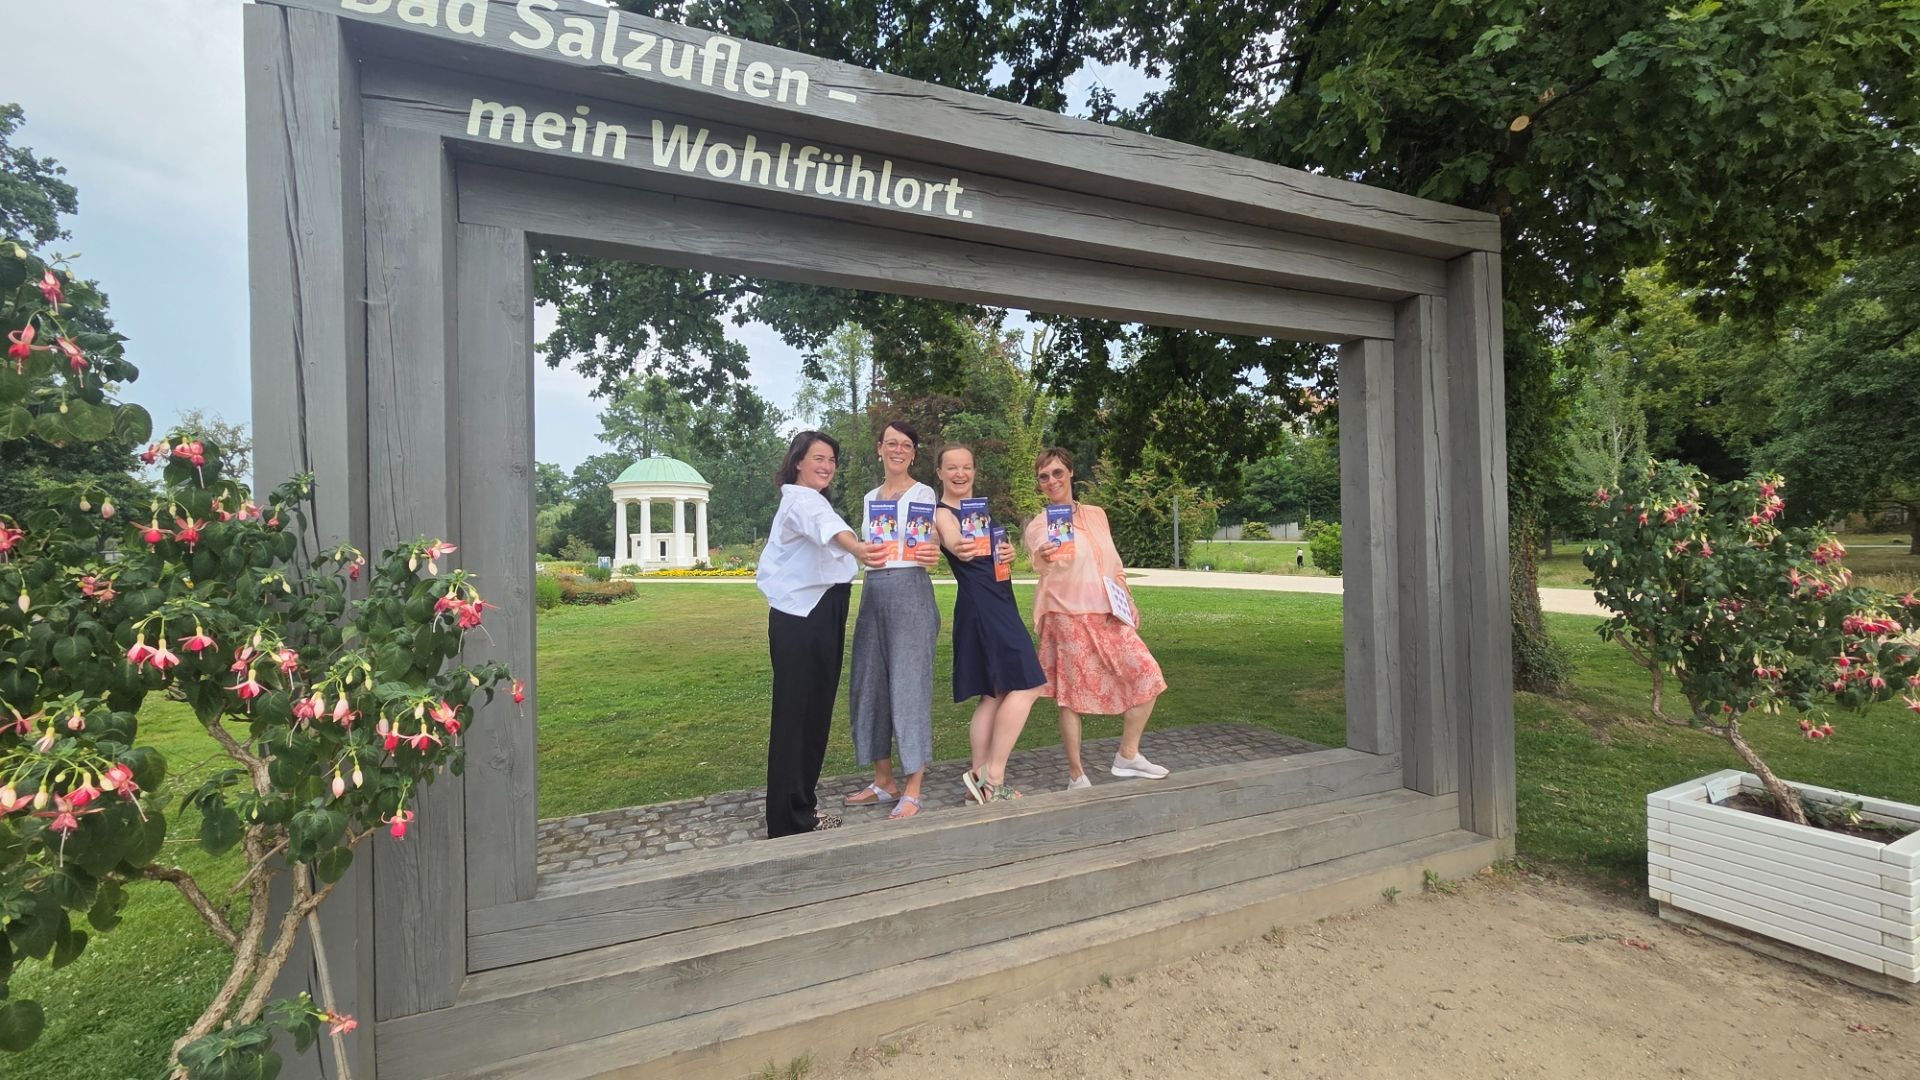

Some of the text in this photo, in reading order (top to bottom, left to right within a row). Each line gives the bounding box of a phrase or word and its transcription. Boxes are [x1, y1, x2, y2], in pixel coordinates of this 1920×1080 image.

[341, 0, 489, 38] ad
[509, 0, 810, 106] Salzuflen
[466, 97, 974, 220] mein Wohlfühlort.
